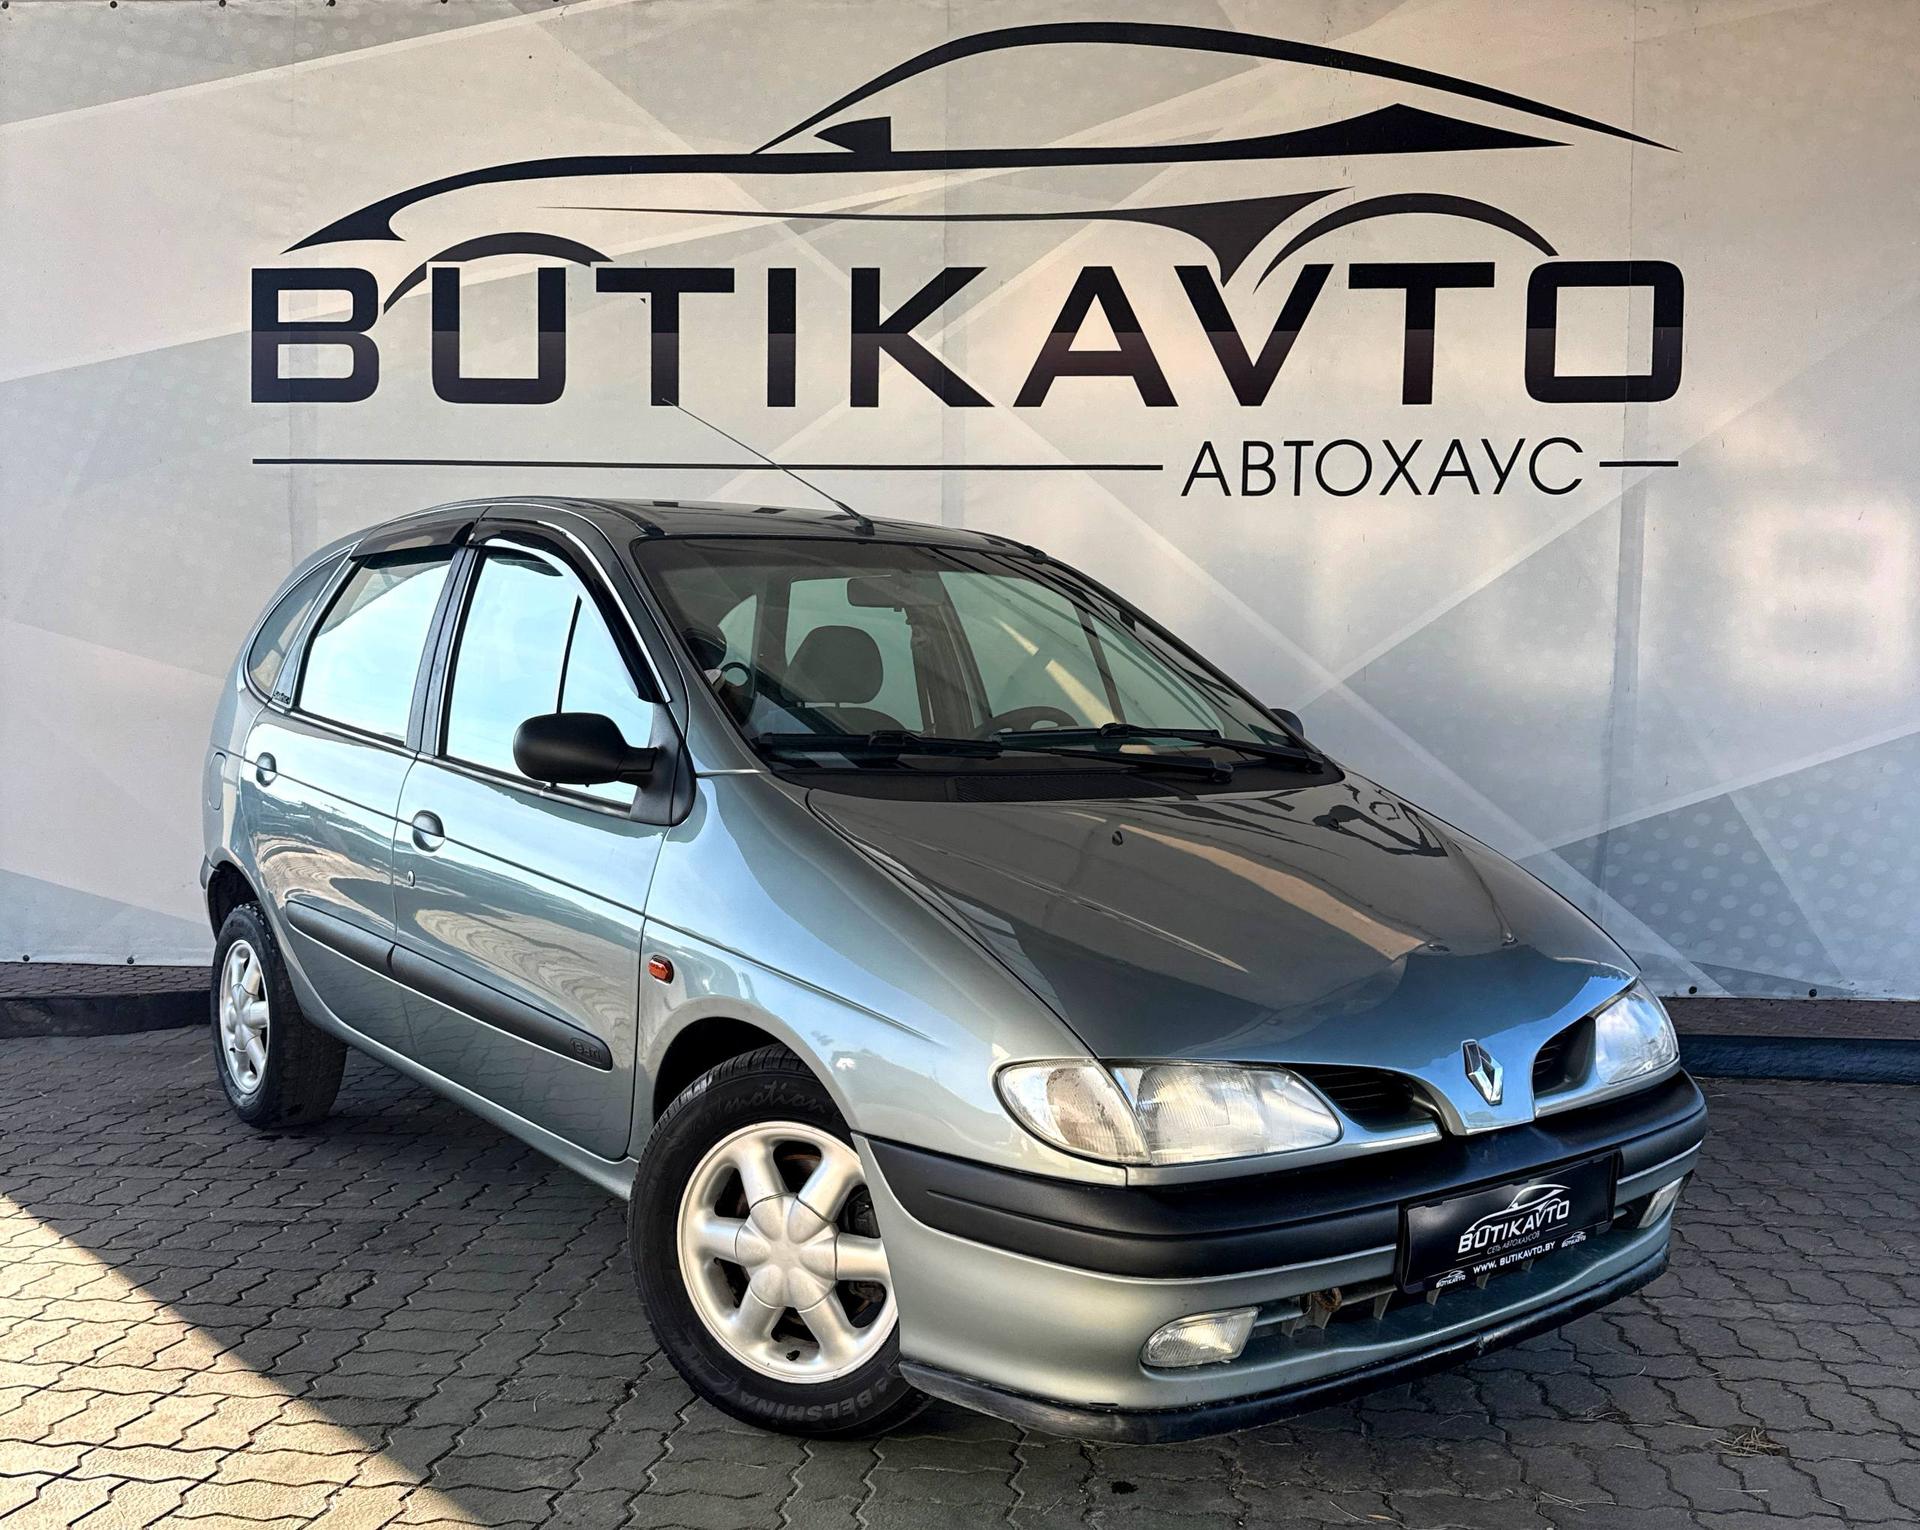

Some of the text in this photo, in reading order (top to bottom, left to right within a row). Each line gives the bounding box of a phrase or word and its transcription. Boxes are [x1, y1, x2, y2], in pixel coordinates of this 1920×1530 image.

[252, 261, 1684, 406] BUTIKAVTO
[1181, 437, 1583, 497] АВТОХАУС
[1458, 1201, 1569, 1253] BUTIKAVTO
[1473, 1241, 1556, 1274] WWW. BUTIKAVTO.BY
